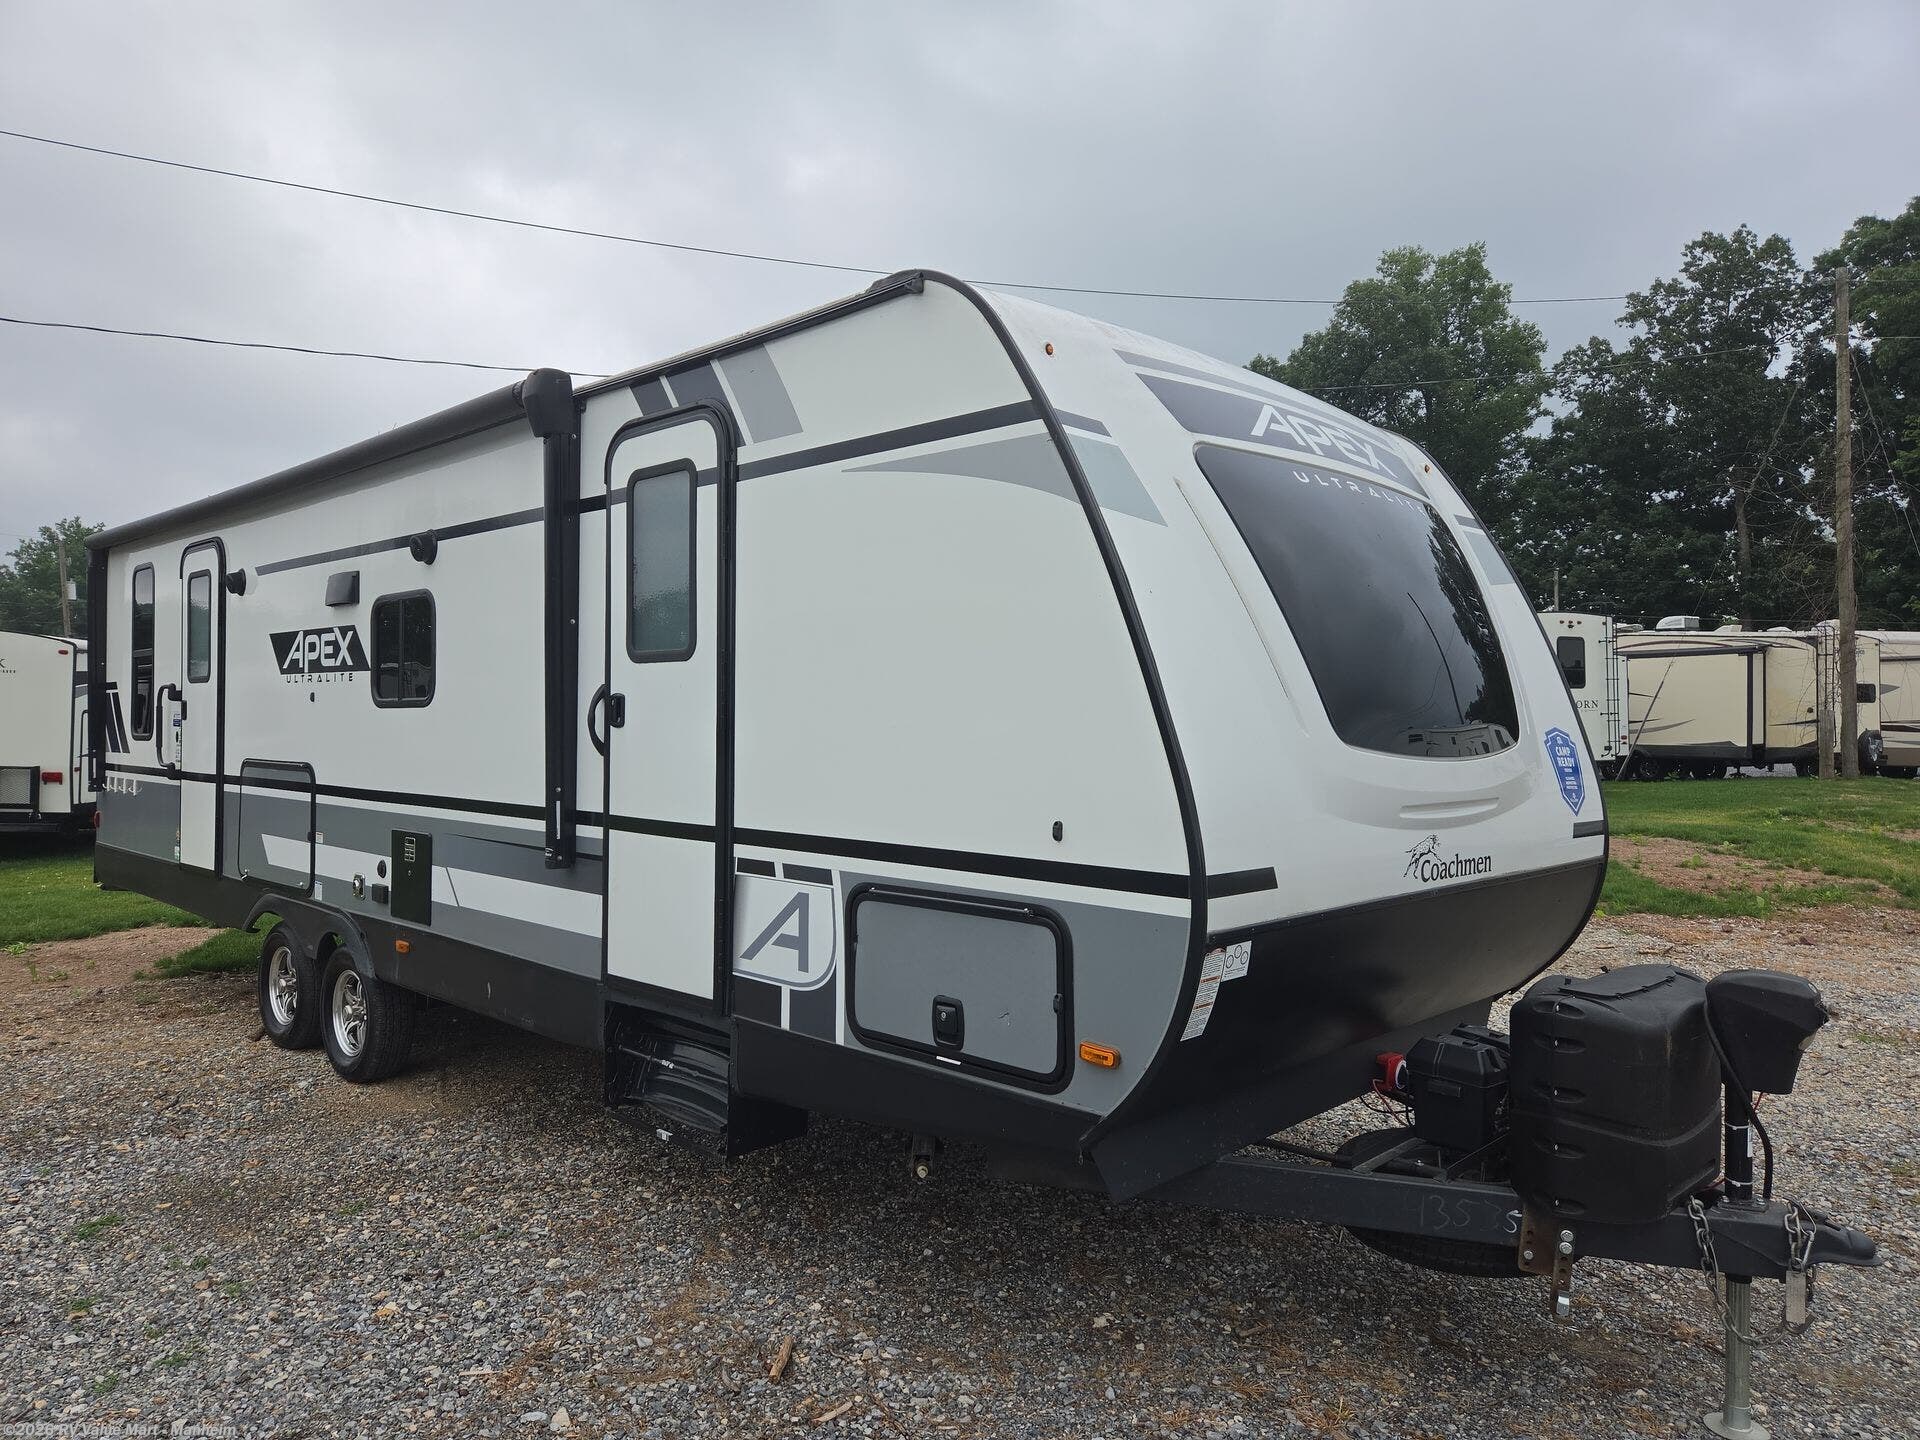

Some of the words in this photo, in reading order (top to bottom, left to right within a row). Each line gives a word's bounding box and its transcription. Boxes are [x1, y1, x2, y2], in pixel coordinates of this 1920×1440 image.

[1250, 404, 1398, 479] APEX
[1292, 471, 1427, 517] ULTRALITE
[282, 627, 354, 673] APEX
[286, 673, 354, 684] ULTRALITE
[1555, 746, 1571, 757] CAMP
[1557, 757, 1575, 768] READY
[1421, 853, 1492, 883] Coachmen
[739, 891, 810, 974] A
